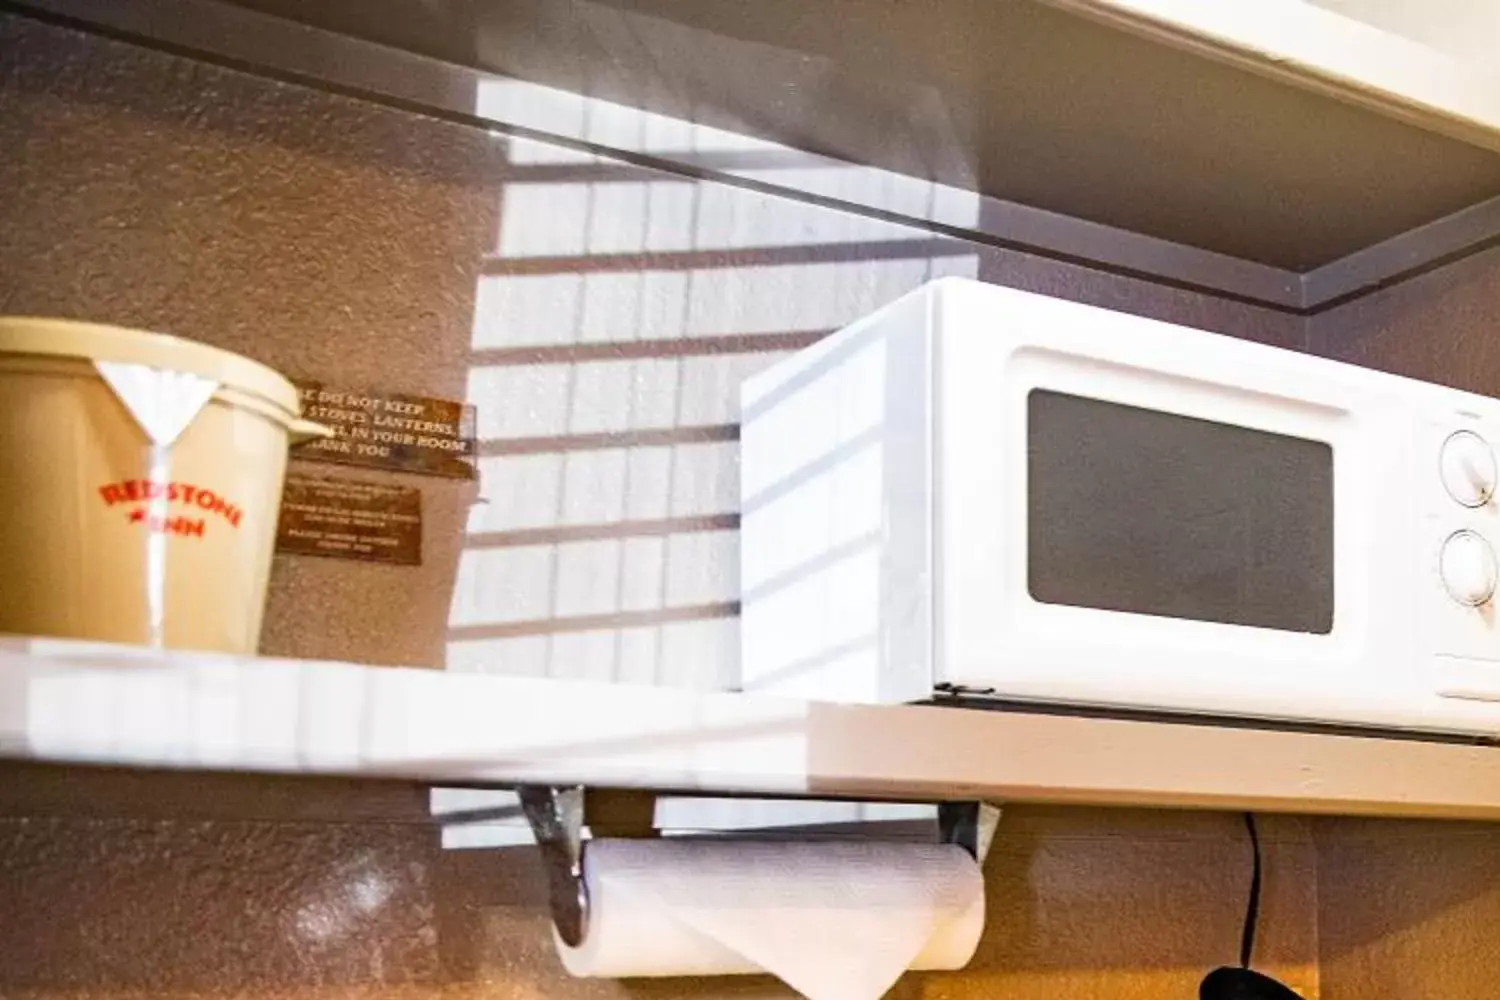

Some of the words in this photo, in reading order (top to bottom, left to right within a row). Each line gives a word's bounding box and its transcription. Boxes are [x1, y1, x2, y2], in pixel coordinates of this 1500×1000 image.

[342, 394, 382, 410] NOT
[356, 443, 390, 457] YOU
[98, 479, 243, 530] REDSTONE
